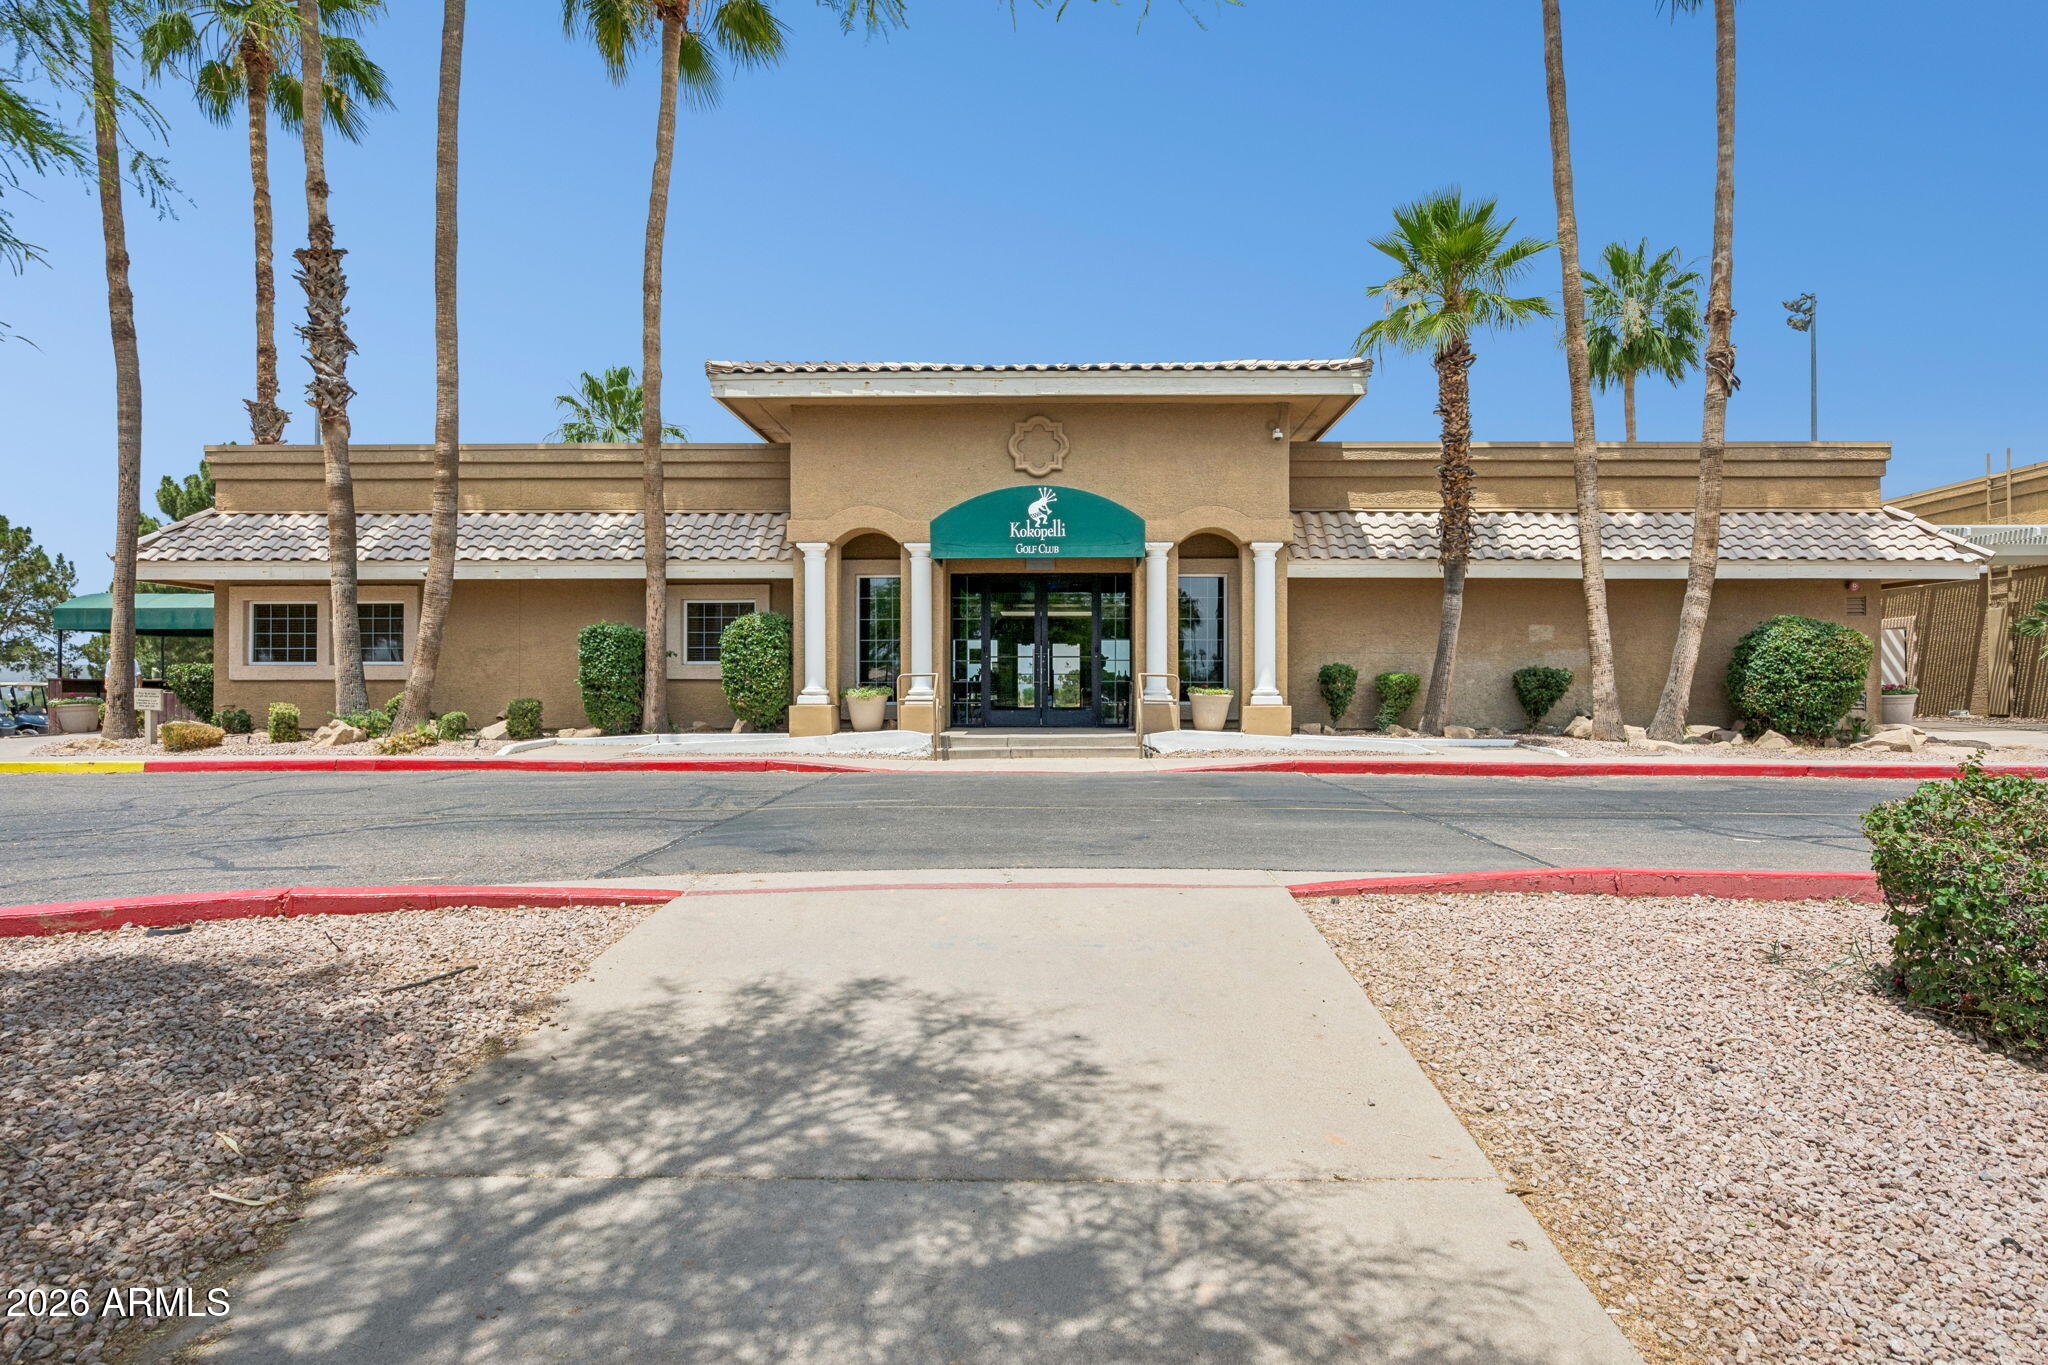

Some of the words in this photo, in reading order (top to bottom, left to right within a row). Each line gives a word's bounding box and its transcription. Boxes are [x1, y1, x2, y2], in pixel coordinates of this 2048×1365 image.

[1009, 518, 1067, 541] Kokopelli
[1015, 543, 1037, 554] GOLF
[1038, 543, 1060, 554] CLUB
